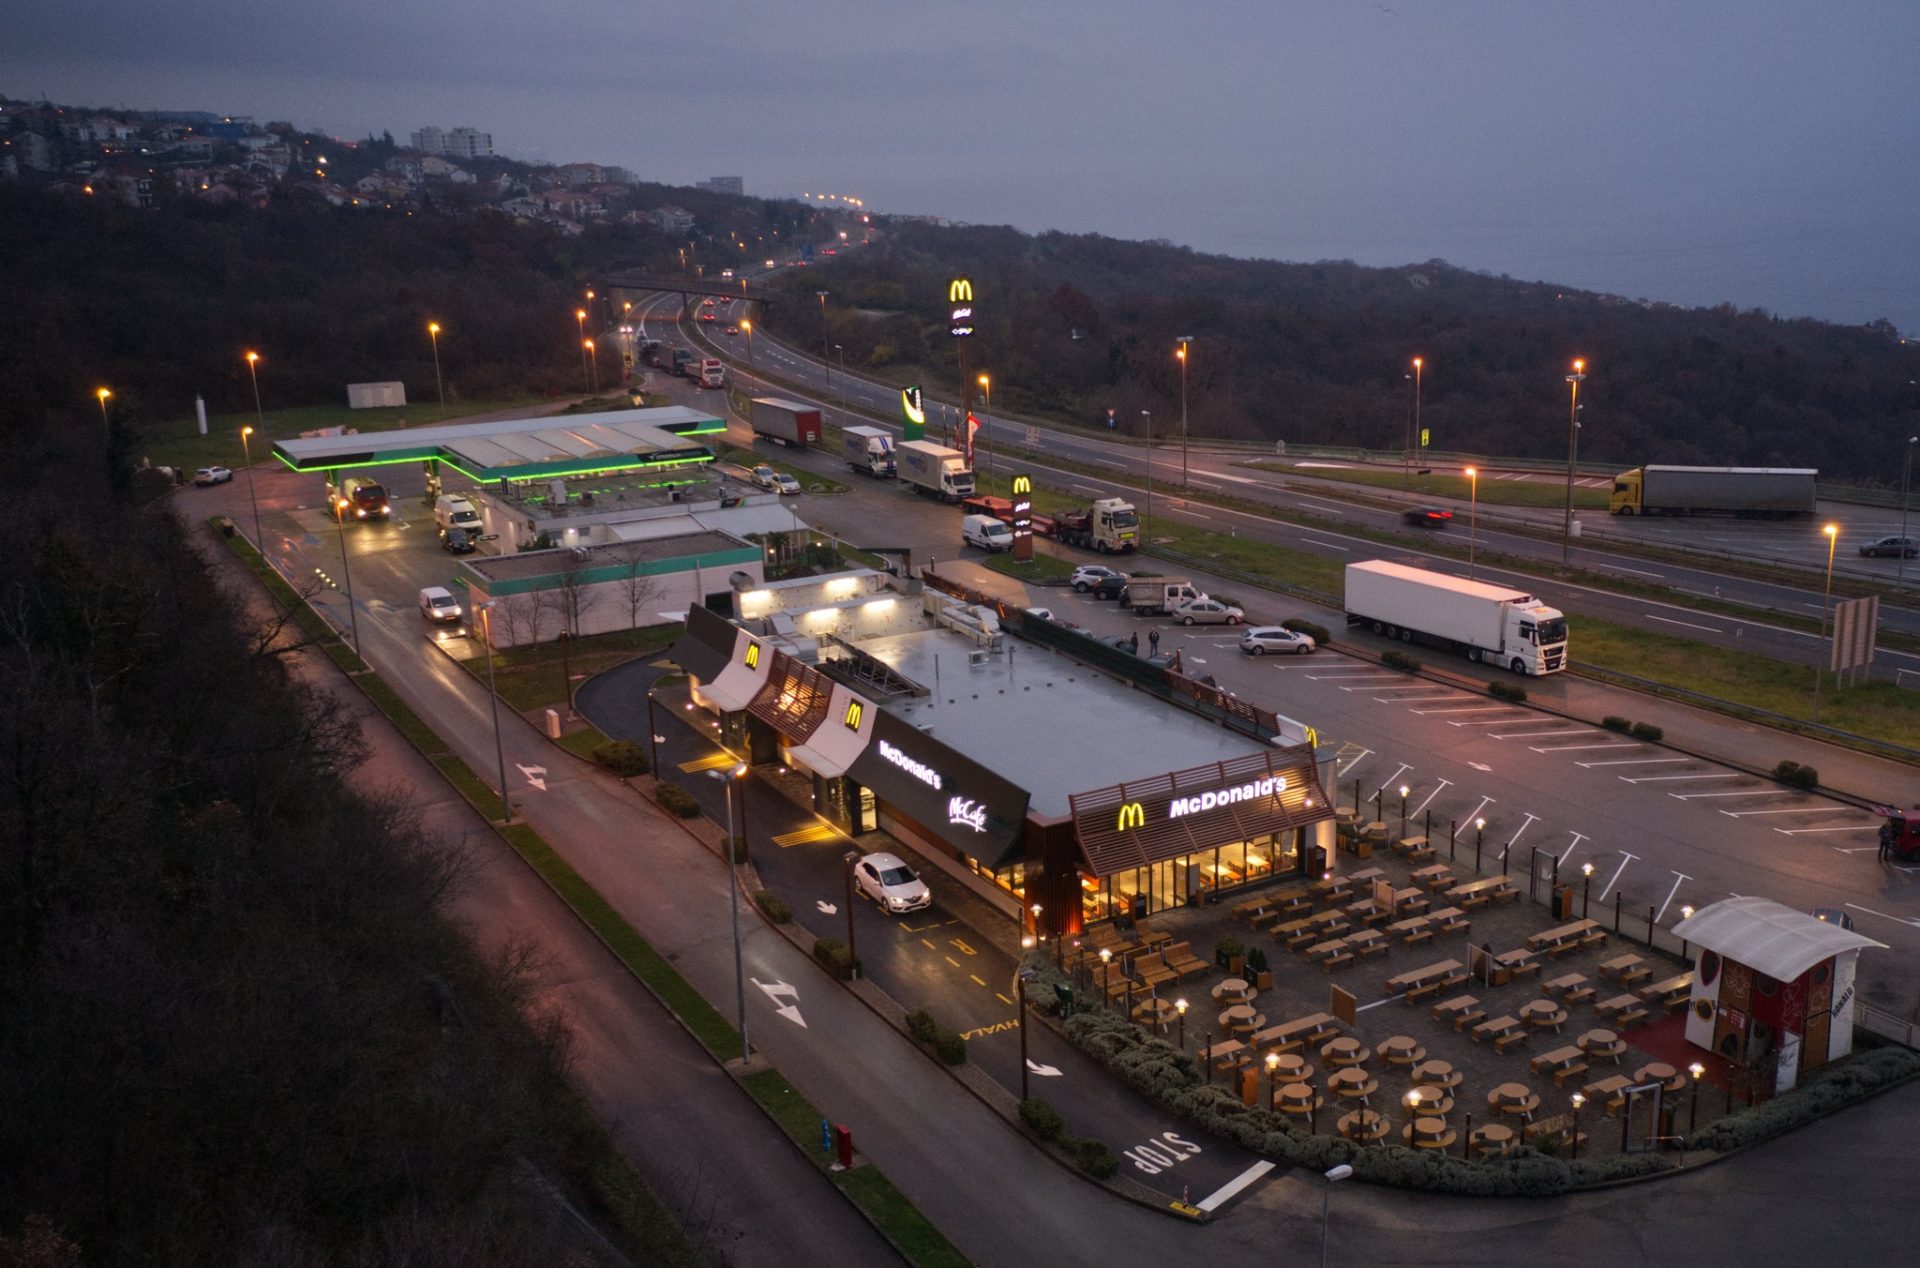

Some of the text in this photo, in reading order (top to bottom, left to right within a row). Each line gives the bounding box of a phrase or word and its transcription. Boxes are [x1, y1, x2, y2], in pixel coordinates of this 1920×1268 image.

[879, 740, 942, 790] McDonald's
[1170, 777, 1287, 819] McDonald's
[959, 1019, 1020, 1041] HVALA
[1123, 1131, 1202, 1174] STOP
